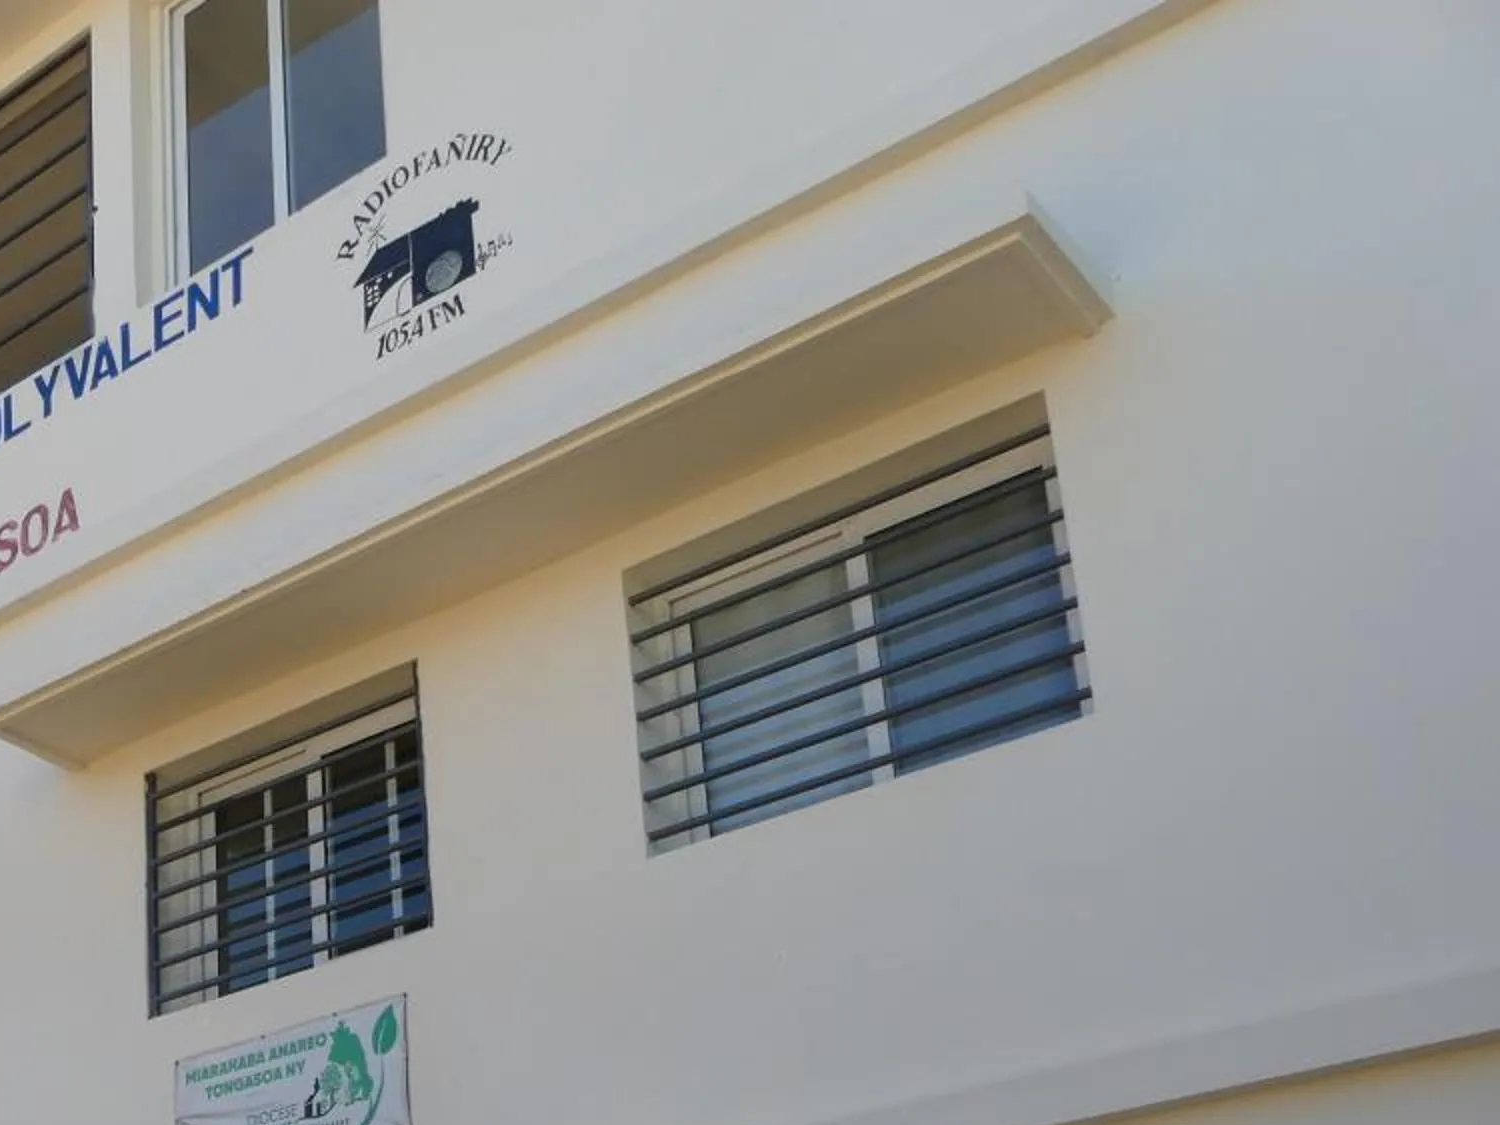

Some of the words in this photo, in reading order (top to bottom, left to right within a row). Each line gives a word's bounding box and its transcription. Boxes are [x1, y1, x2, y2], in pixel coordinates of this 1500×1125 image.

[429, 293, 465, 330] FM
[204, 1066, 283, 1101] TONGASOA
[285, 1059, 306, 1077] NY
